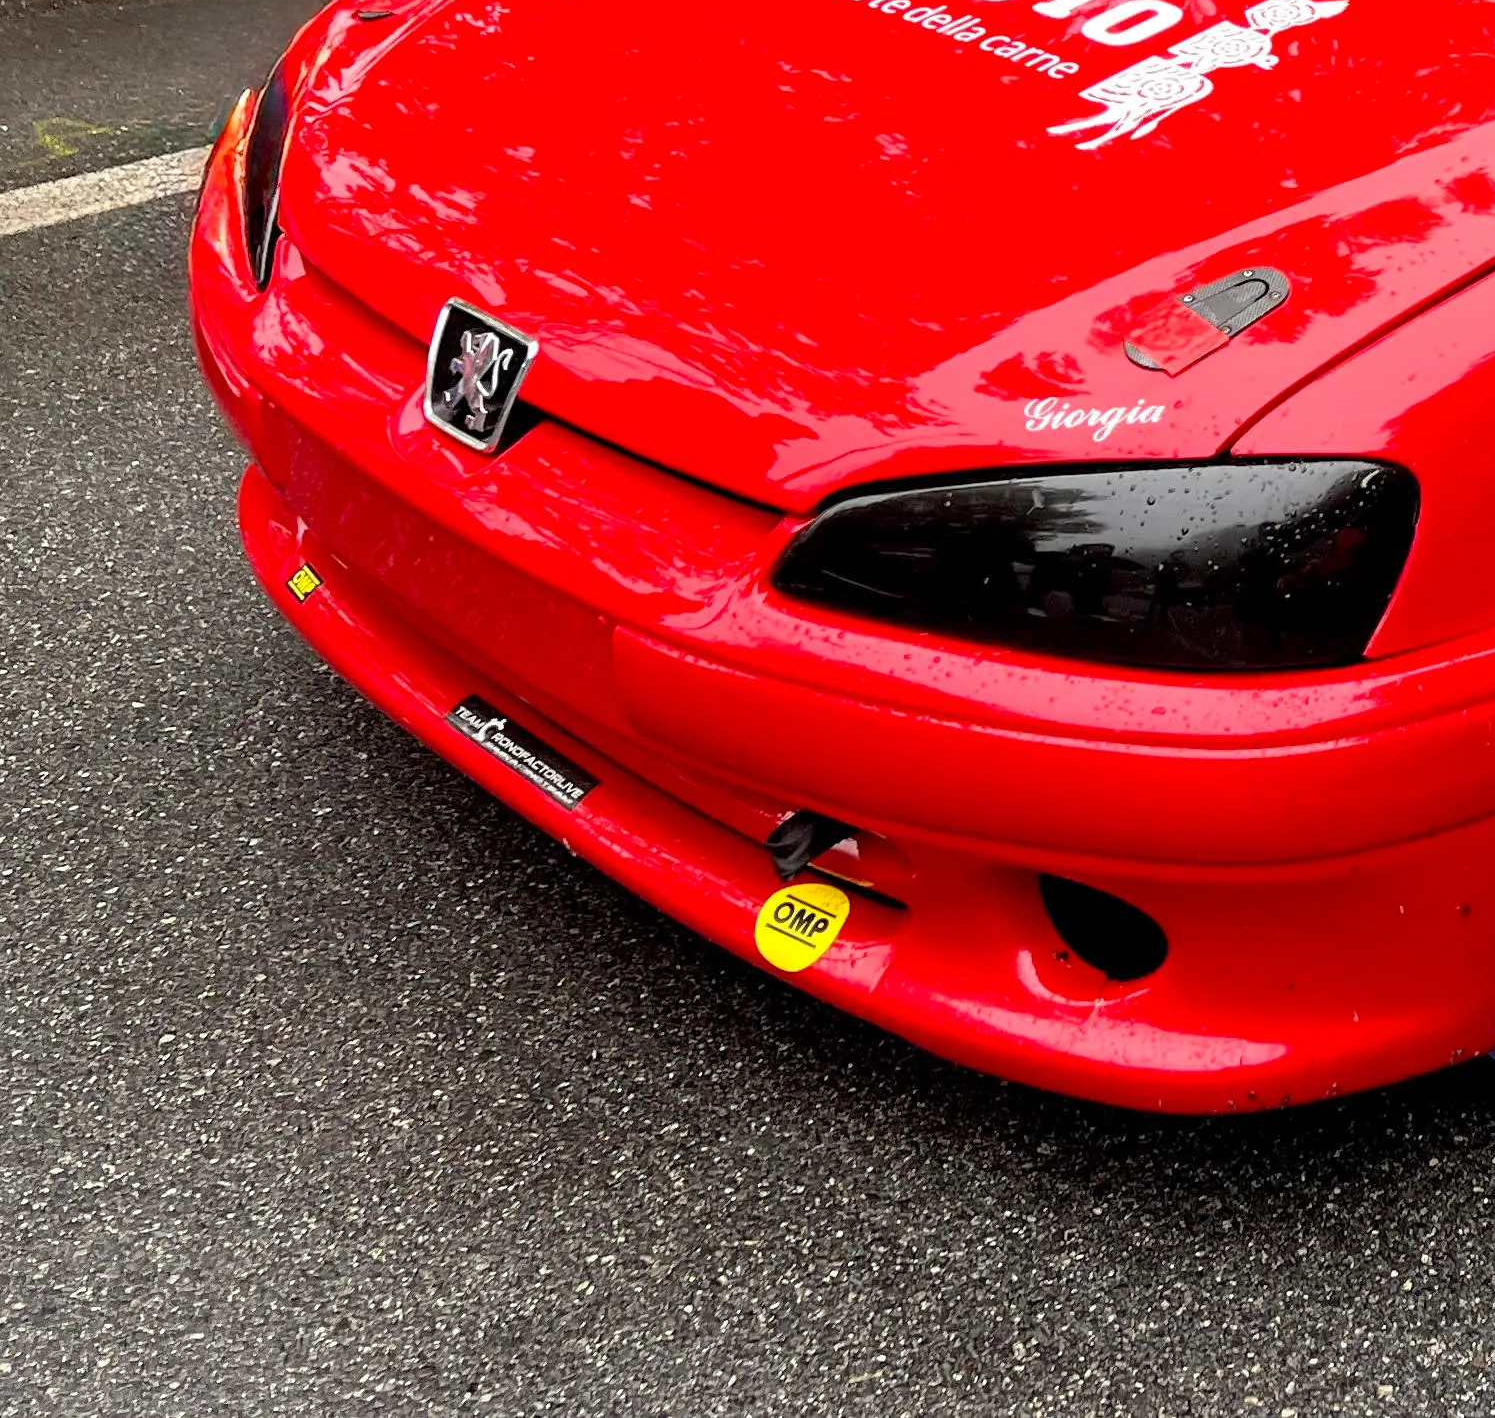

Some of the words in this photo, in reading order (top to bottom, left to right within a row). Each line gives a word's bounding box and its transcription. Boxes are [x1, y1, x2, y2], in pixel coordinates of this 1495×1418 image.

[902, 5, 986, 42] della
[979, 35, 1079, 79] carne
[1024, 397, 1166, 442] Giorgia
[455, 705, 486, 730] TEAM
[773, 901, 830, 938] OMP
